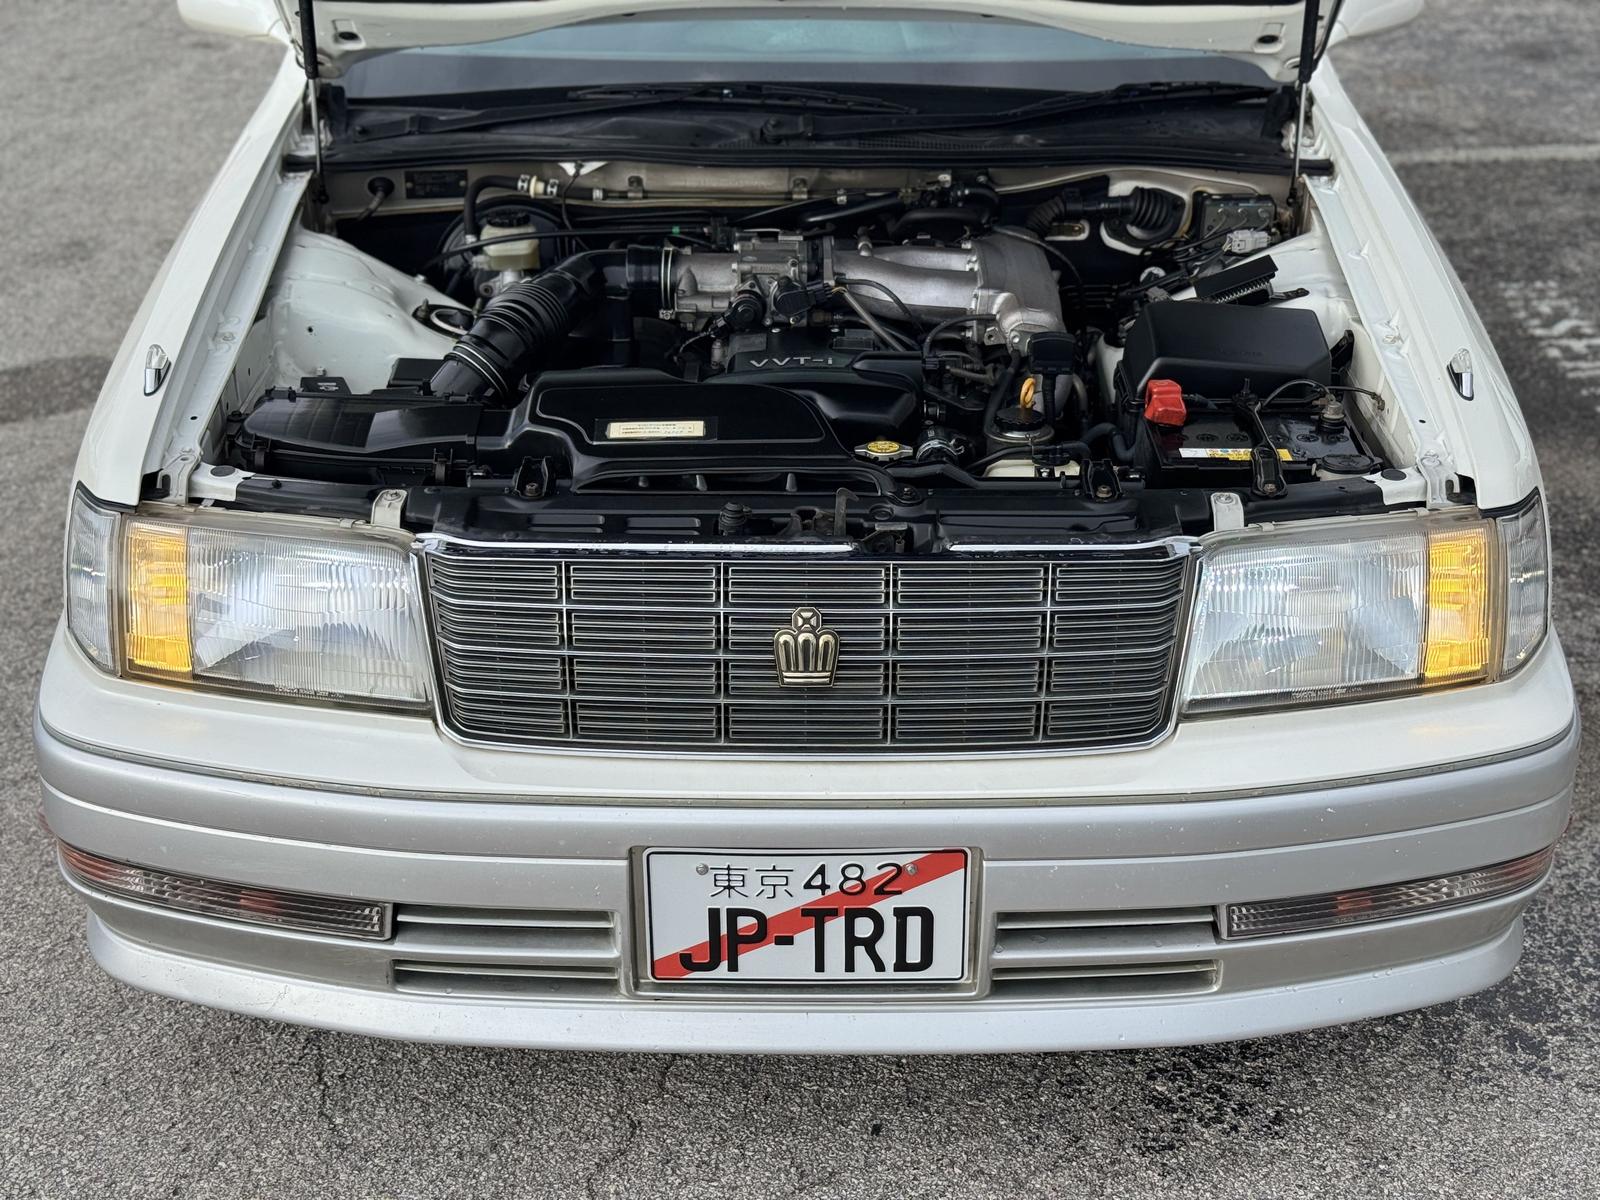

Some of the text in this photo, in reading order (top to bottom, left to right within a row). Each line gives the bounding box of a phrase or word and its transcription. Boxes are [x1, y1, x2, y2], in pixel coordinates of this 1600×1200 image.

[709, 862, 903, 899] 東京 482
[679, 905, 935, 973] JP-TRD
